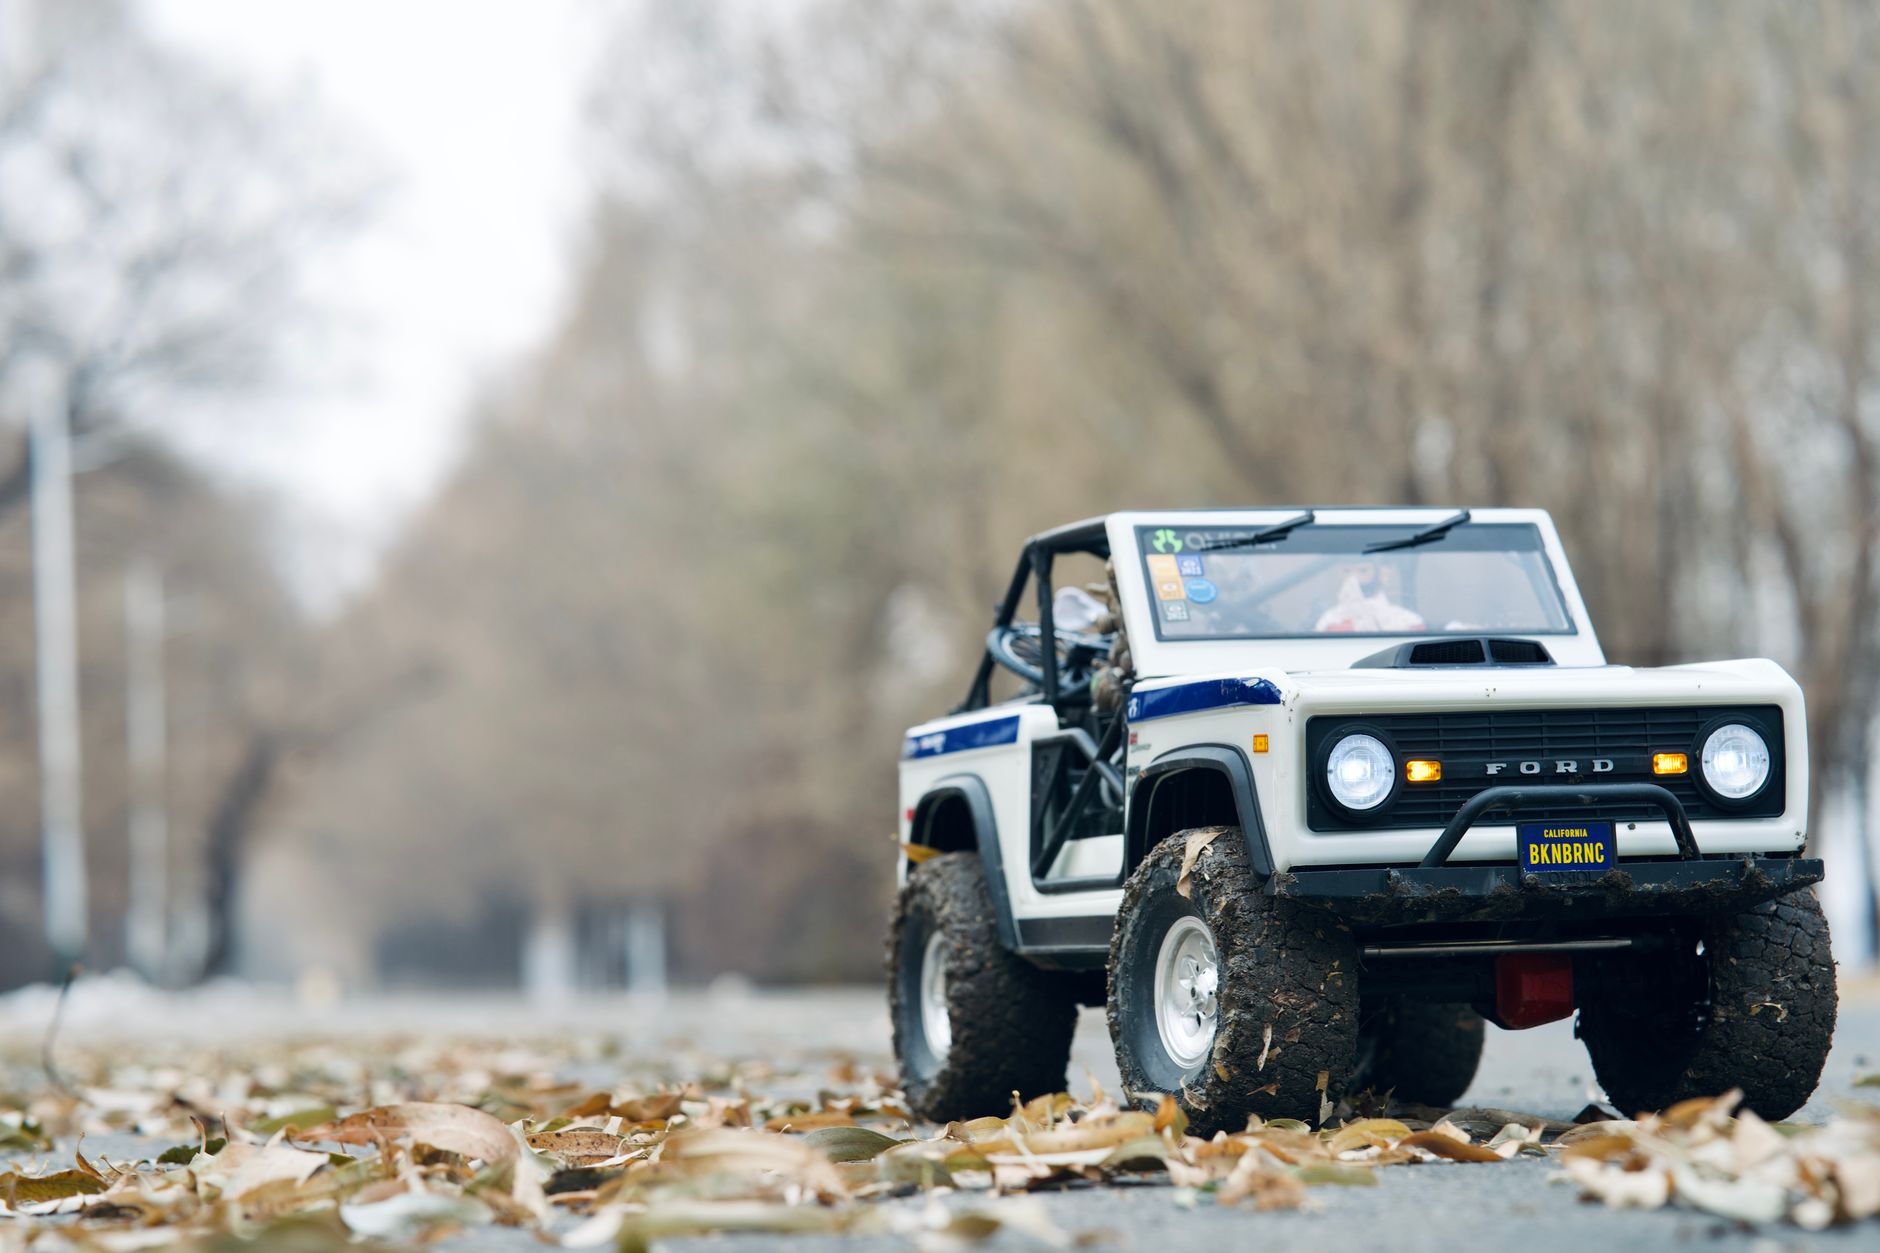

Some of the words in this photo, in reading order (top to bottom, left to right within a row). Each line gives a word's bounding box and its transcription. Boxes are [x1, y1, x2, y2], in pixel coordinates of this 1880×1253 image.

[1486, 759, 1614, 775] FORD
[1543, 828, 1588, 838] CALIFORNIA
[1529, 842, 1605, 865] BKNBRNC
